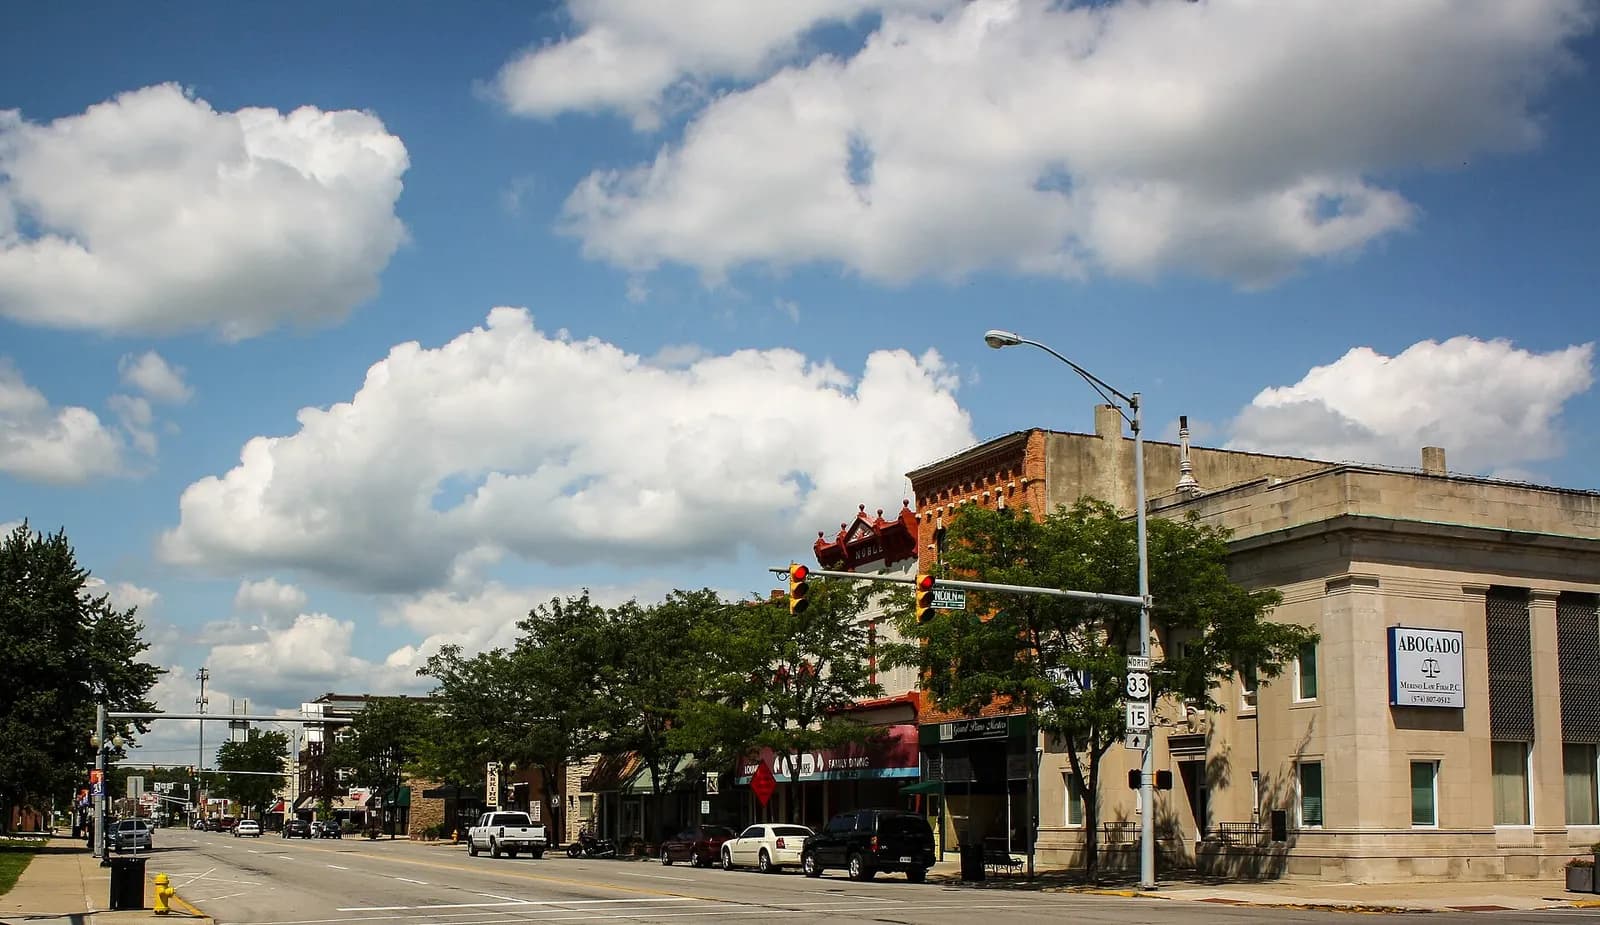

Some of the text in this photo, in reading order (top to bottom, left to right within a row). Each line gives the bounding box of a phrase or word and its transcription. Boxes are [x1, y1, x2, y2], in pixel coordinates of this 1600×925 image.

[855, 544, 884, 560] NOBLE
[932, 590, 958, 601] NCOLN
[1398, 635, 1460, 654] ABOGADO
[1128, 657, 1147, 667] NORTH
[1129, 677, 1147, 692] 33
[1423, 682, 1435, 690] LAW
[1131, 711, 1146, 726] 15
[828, 759, 848, 769] FAMILY
[848, 756, 870, 768] DINING
